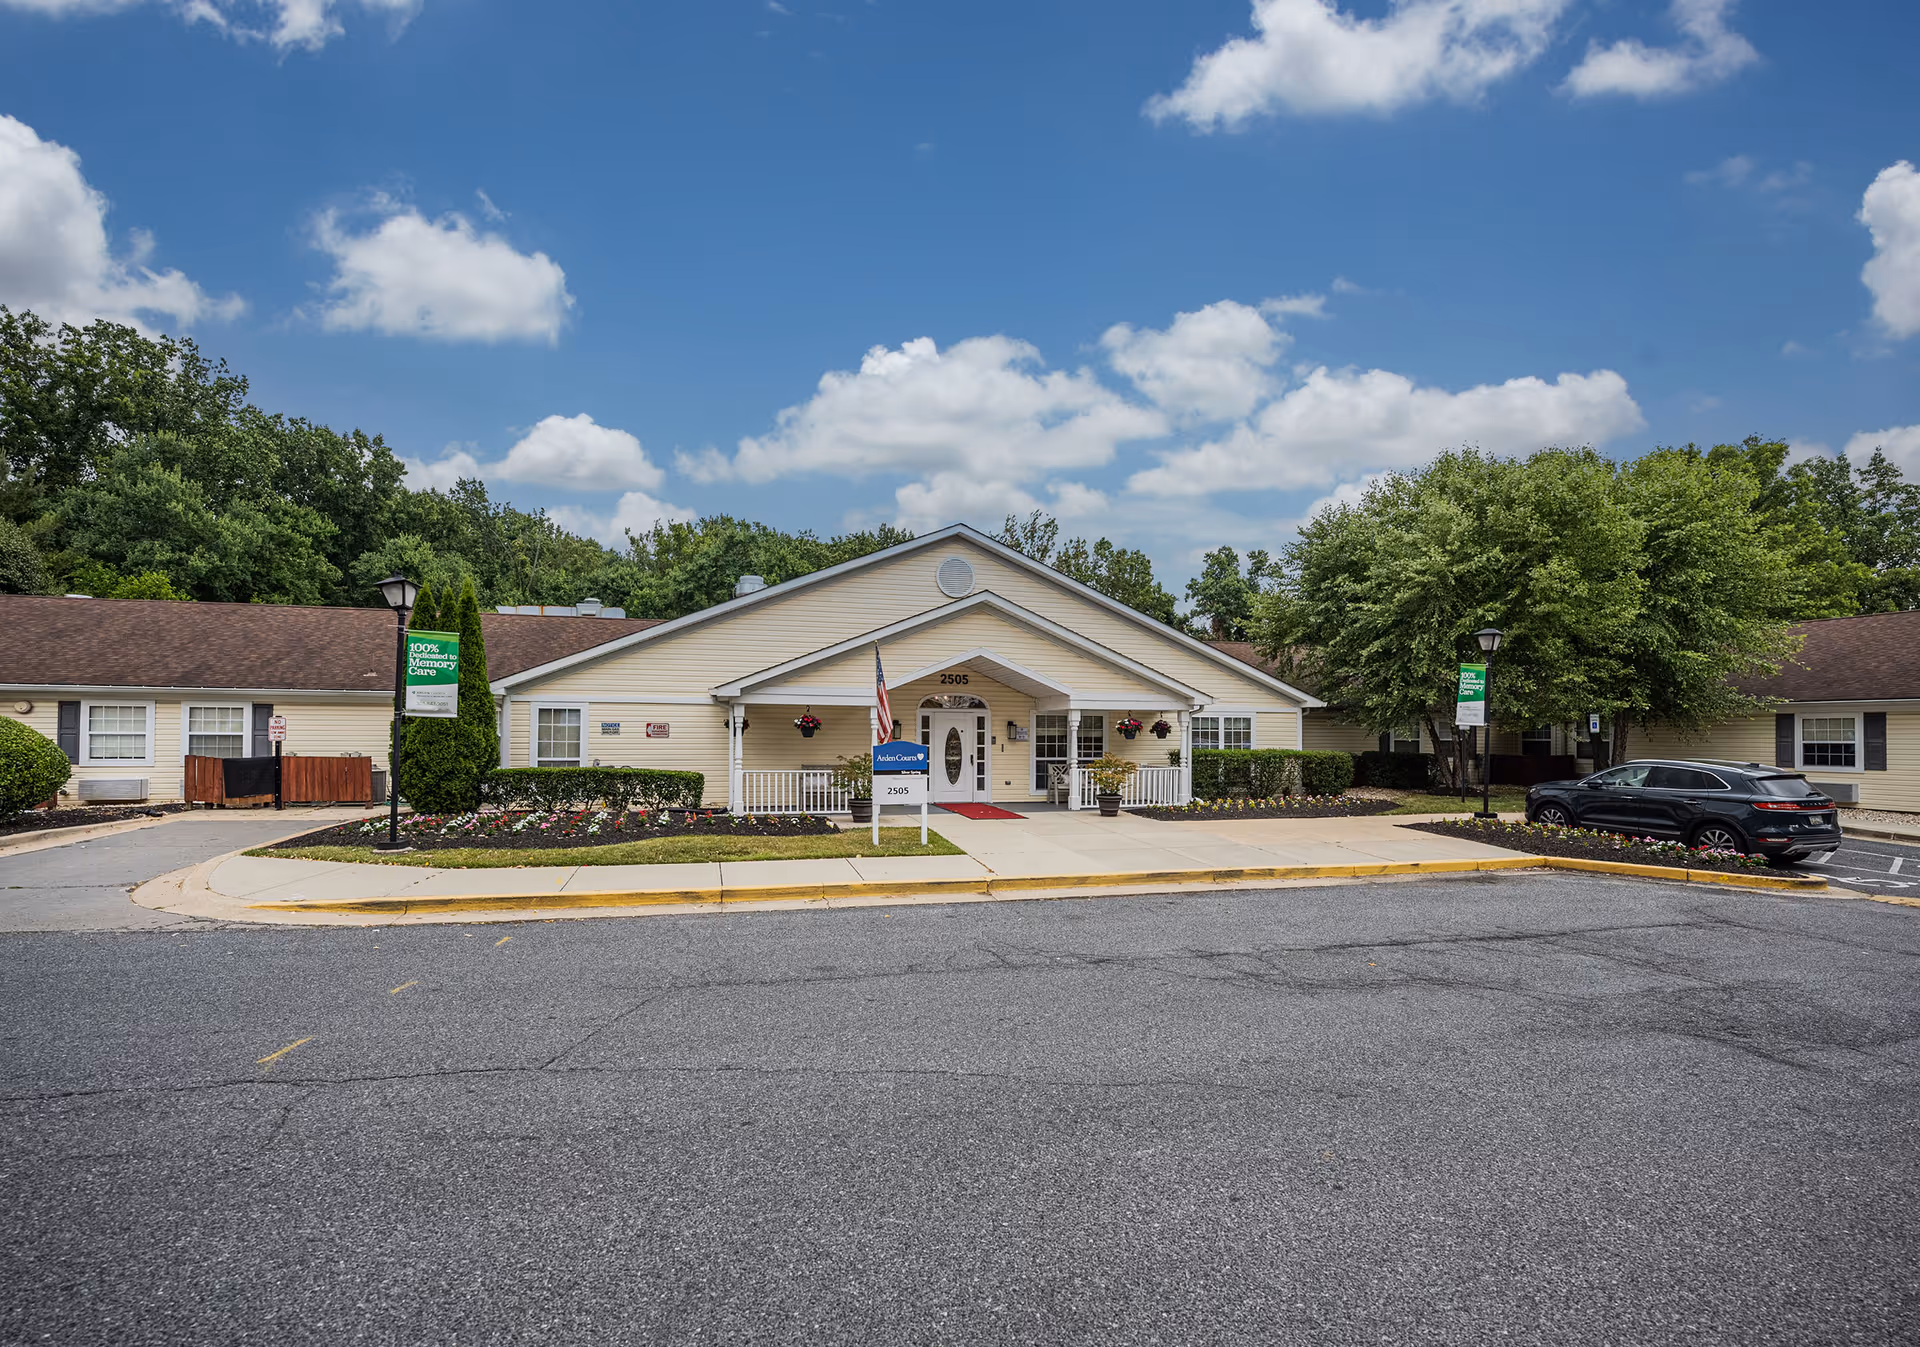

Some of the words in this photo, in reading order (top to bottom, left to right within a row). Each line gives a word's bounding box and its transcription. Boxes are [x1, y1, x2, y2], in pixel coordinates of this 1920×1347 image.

[409, 643, 439, 653] 100%
[409, 652, 448, 660] Dedicated
[408, 658, 457, 670] Memory
[408, 667, 437, 676] Care
[940, 673, 969, 685] 2505
[1460, 682, 1485, 691] Memory
[877, 754, 896, 762] Arden
[896, 754, 917, 762] Courts
[887, 787, 910, 795] 2505
